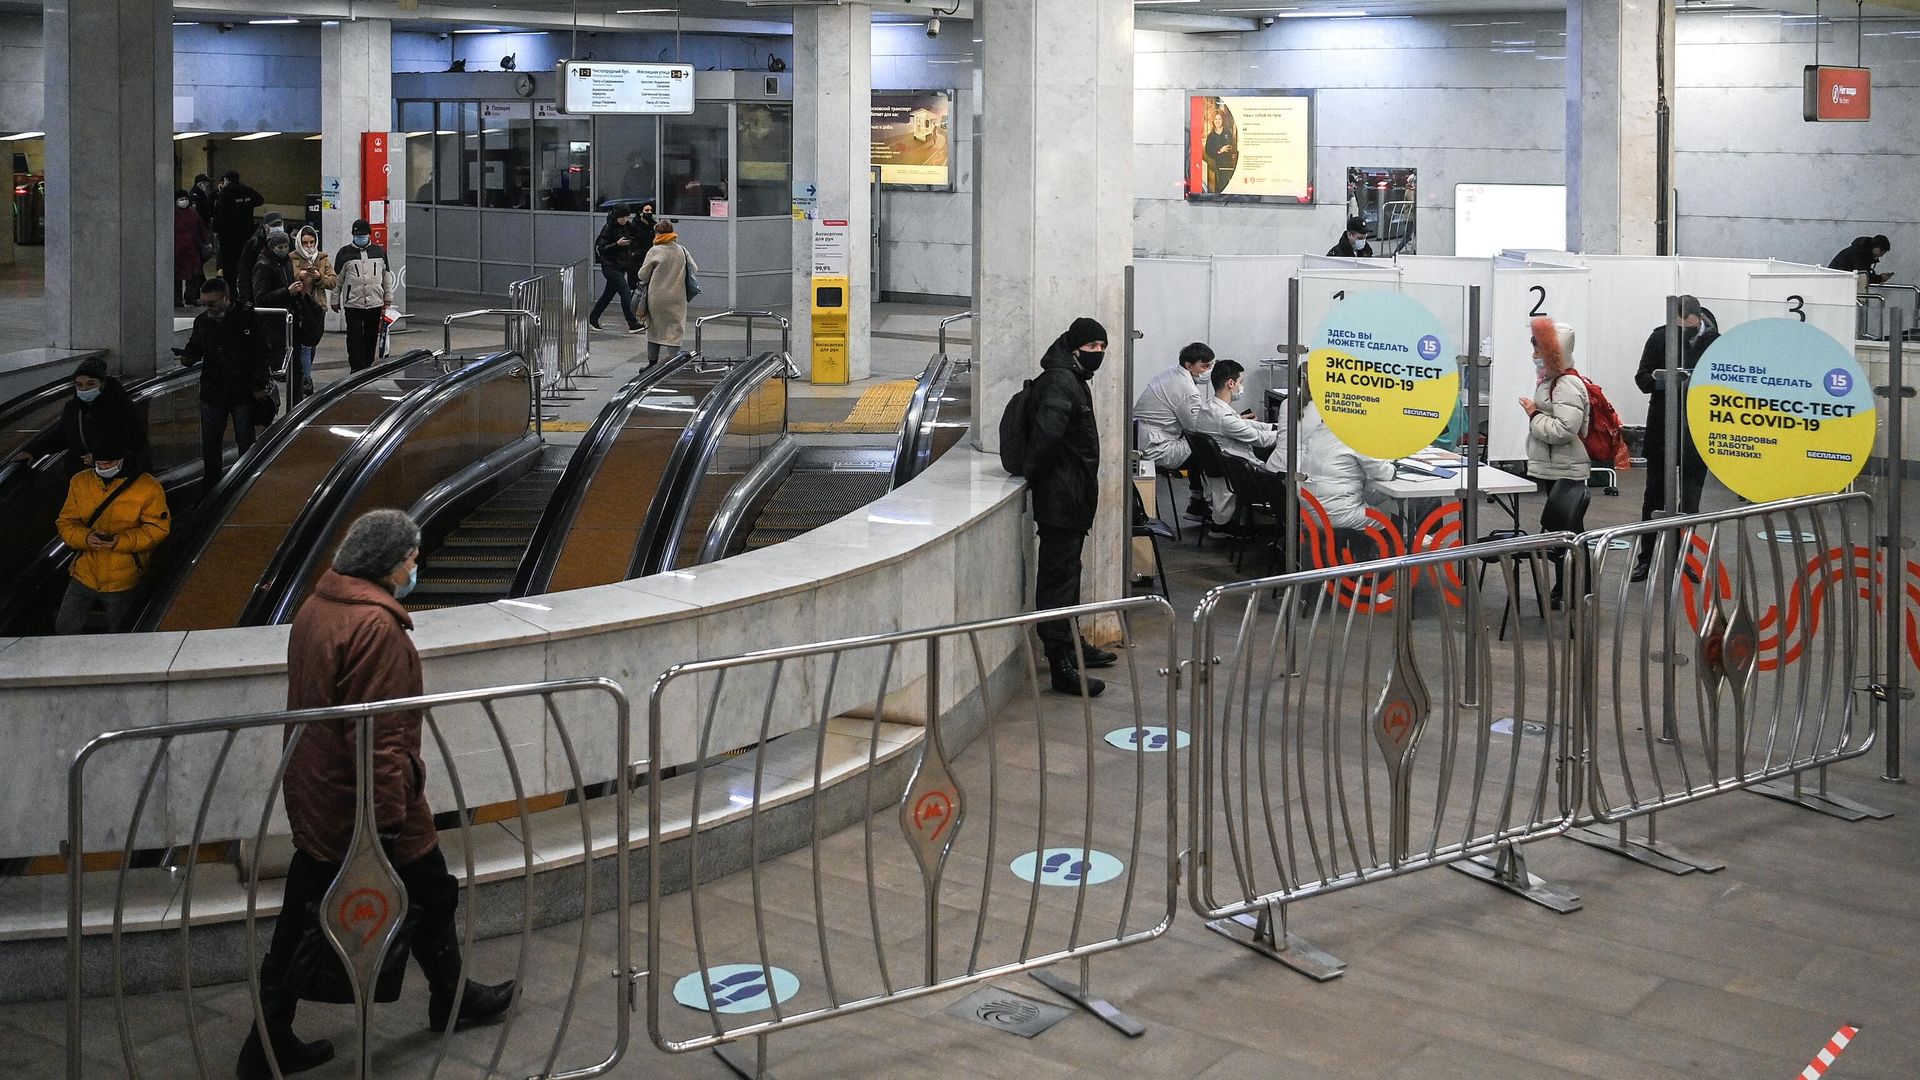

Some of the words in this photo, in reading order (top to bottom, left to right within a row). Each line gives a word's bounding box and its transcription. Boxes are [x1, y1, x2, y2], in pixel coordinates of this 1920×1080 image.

[1529, 286, 1547, 317] 2
[1786, 295, 1806, 322] 3
[1328, 329, 1356, 339] ЗДЕСЬ
[1358, 332, 1372, 340] ВЫ
[1328, 338, 1366, 349] МОЖЕТЕ
[1367, 342, 1408, 353] СДЕЛАТЬ
[1423, 340, 1436, 352] 15
[1326, 357, 1442, 380] ЭКСПРЕСС-ТЕСТ
[1710, 363, 1746, 374] ЗДЕСЬ
[1749, 366, 1766, 374] ВЫ
[1326, 372, 1346, 384] НА
[1350, 375, 1414, 392] COVID-19
[1710, 374, 1757, 384] МОЖЕТЕ
[1760, 377, 1812, 388] СДЕЛАТЬ
[1830, 374, 1847, 386] 15
[1324, 392, 1340, 400] ДЛЯ
[1341, 394, 1380, 403] ЗДОРОВЬЯ
[1332, 400, 1362, 408] ЗАБОТЫ
[1709, 394, 1856, 418] ЭКСПРЕСС-ТЕСТ
[1332, 406, 1367, 416] БЛИЗКИХ!
[1404, 408, 1439, 418] БЕСПЛАТНО
[1709, 410, 1735, 424] НА
[1740, 414, 1820, 432] COVID-19
[1708, 432, 1728, 440] ДЛЯ
[1729, 434, 1778, 445] ЗДОРОВЬЯ
[1716, 441, 1754, 451] ЗАБОТЫ
[1716, 448, 1762, 459] БЛИЗКИХ!
[1808, 451, 1852, 461] БЕСПЛАТНО
